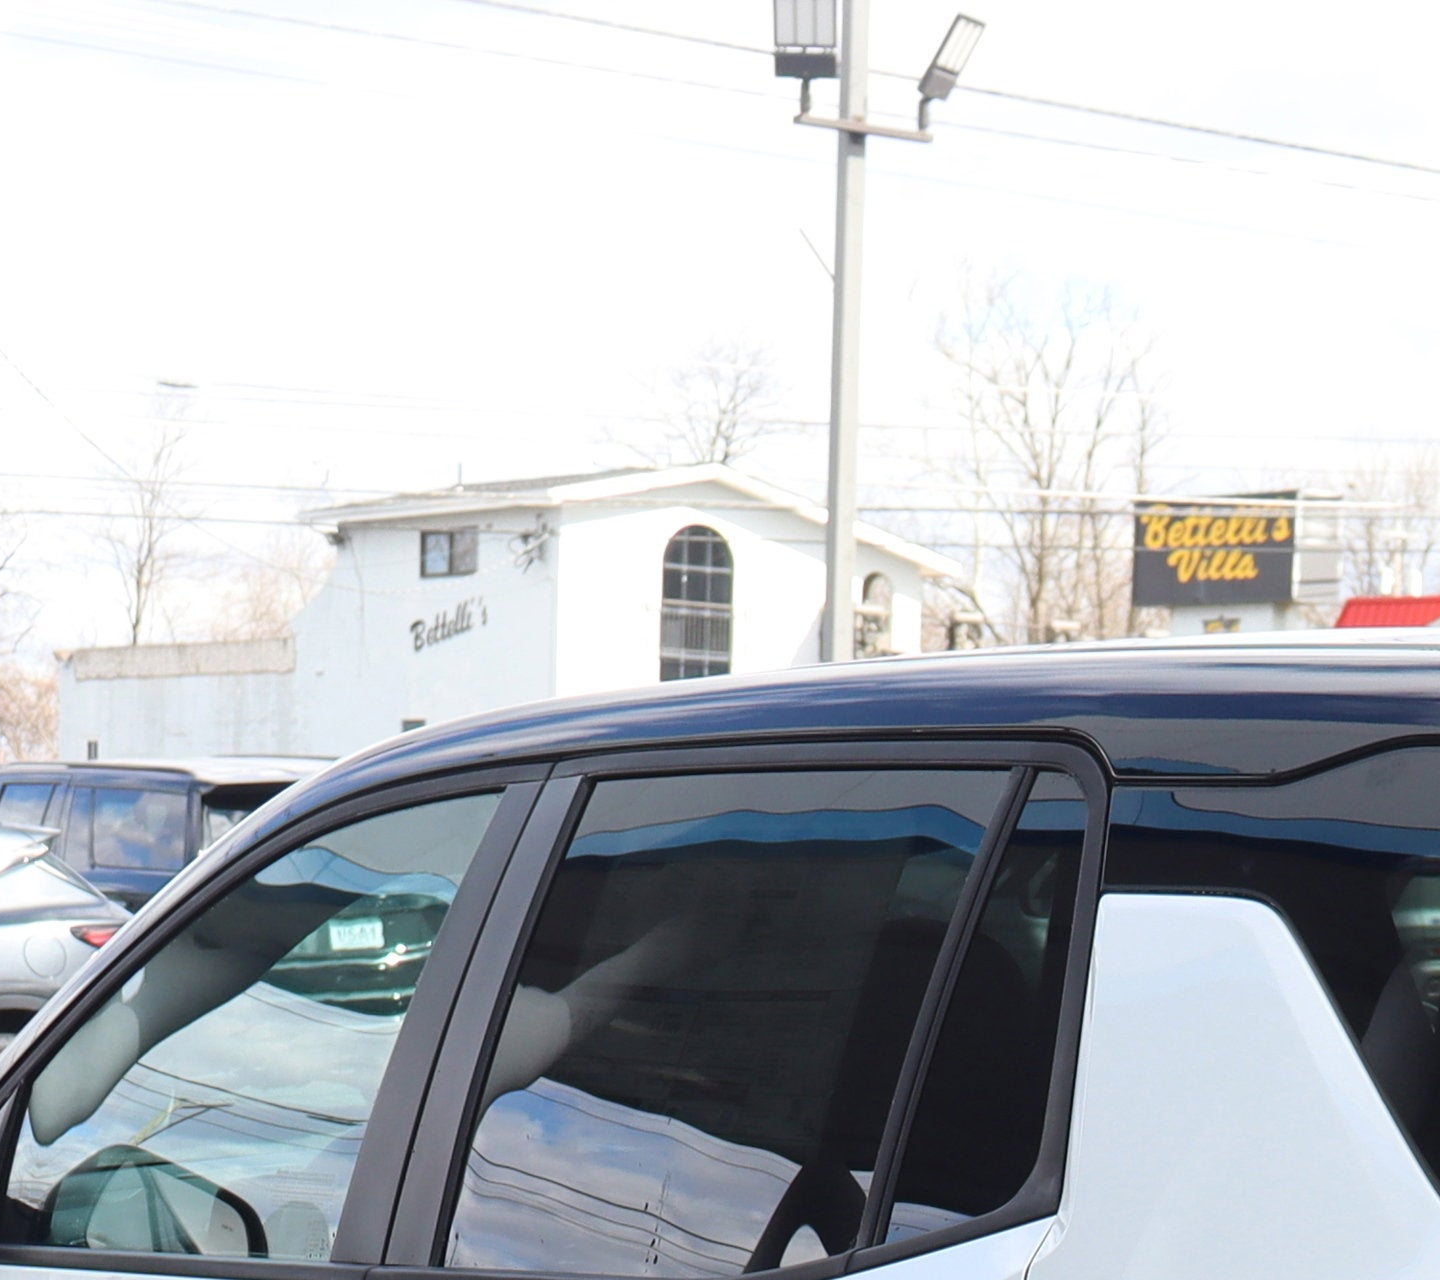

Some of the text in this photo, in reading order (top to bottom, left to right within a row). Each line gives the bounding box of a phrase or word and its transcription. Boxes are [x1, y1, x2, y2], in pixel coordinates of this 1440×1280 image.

[1140, 503, 1290, 549] Bettelli's
[1167, 549, 1259, 583] Villa
[410, 597, 488, 653] Bettelli's
